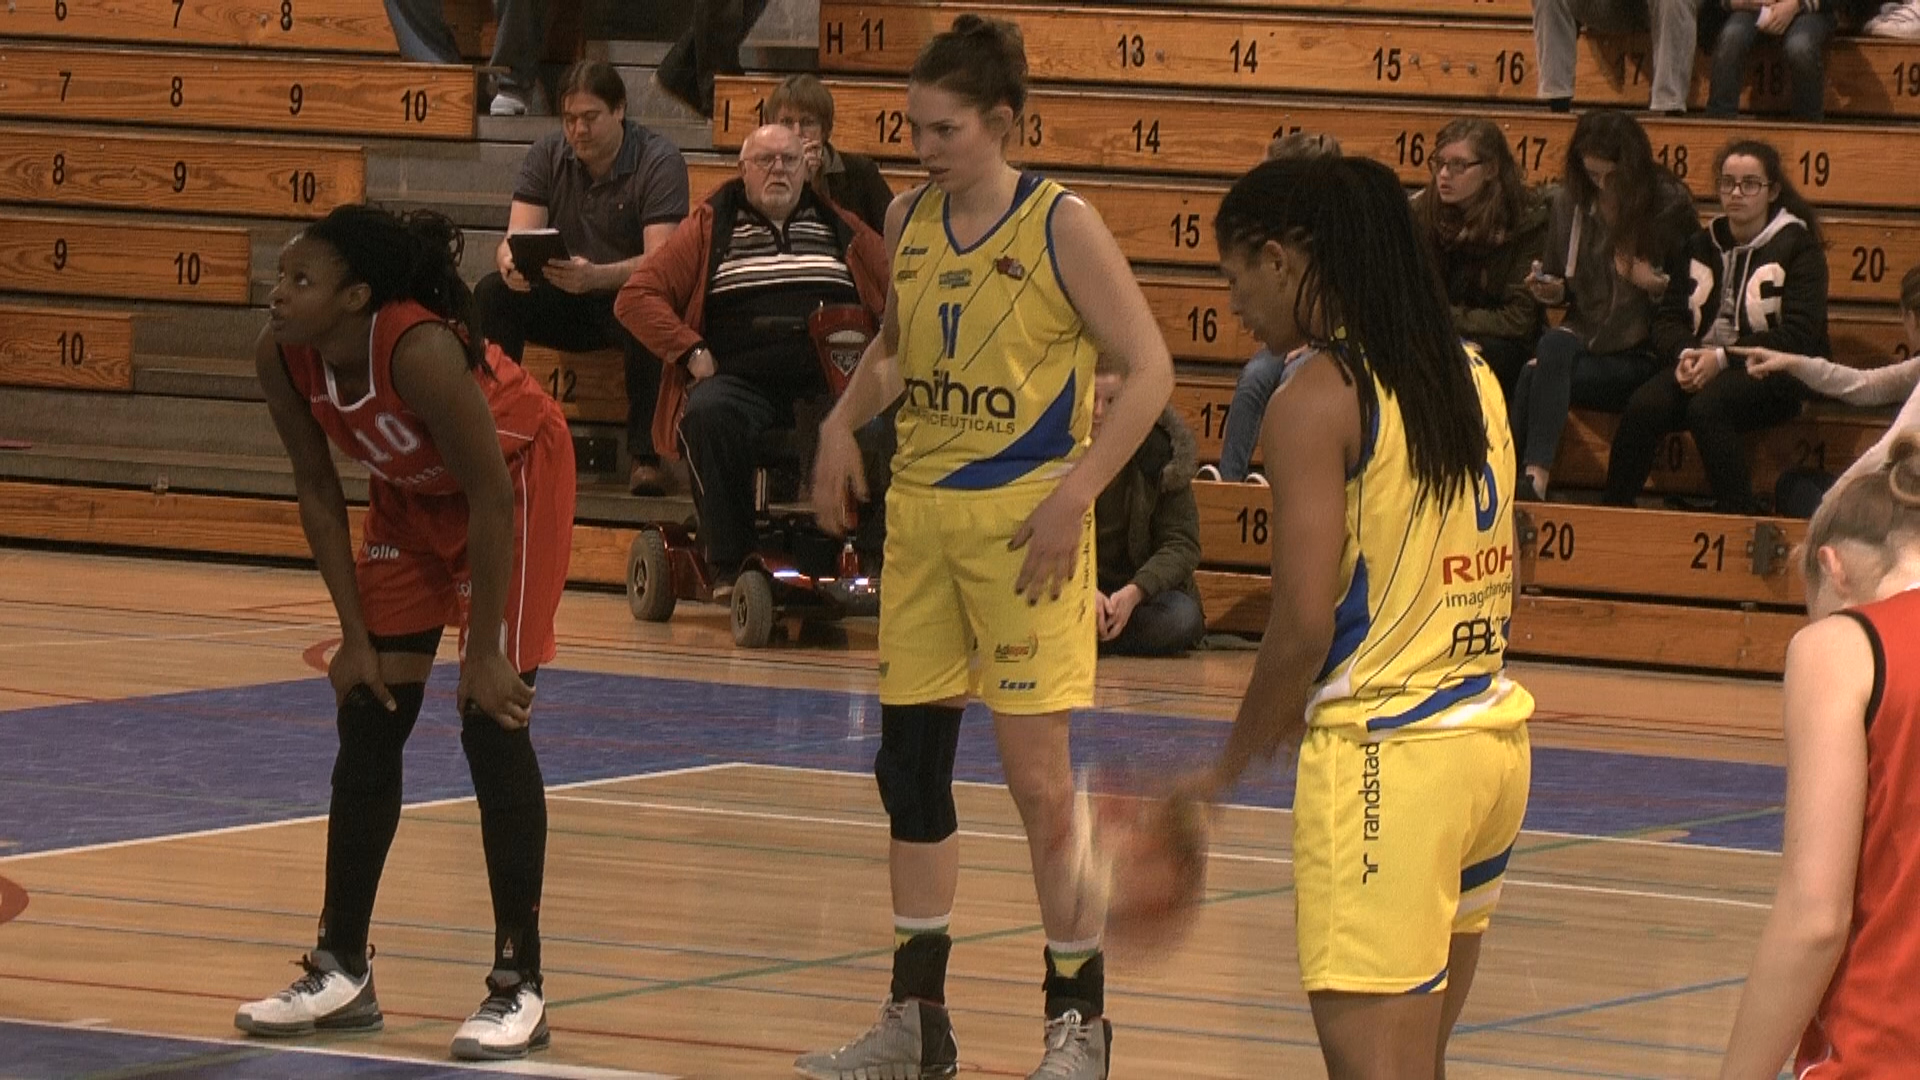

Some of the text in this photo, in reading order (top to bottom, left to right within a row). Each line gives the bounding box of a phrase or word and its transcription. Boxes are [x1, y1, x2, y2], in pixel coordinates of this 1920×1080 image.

[172, 0, 185, 28] 7
[280, 0, 293, 31] 8
[826, 18, 885, 54] H 11
[1117, 34, 1145, 68] 13
[1230, 39, 1259, 74] 14
[1373, 47, 1401, 82] 15
[1495, 50, 1525, 85] 16
[1615, 51, 1644, 86] 17
[58, 71, 72, 101] 7
[170, 76, 183, 107] 8
[1893, 61, 1920, 97] 19
[289, 84, 303, 115] 9
[401, 90, 427, 122] 10
[755, 98, 765, 127] 1
[875, 109, 903, 144] 12
[1016, 113, 1042, 147] 13
[1132, 119, 1160, 154] 14
[1395, 131, 1425, 167] 16
[1516, 136, 1547, 171] 17
[1658, 144, 1688, 179] 18
[52, 153, 65, 185] 8
[173, 161, 187, 193] 9
[1800, 151, 1830, 187] 19
[289, 170, 316, 204] 10
[1170, 213, 1200, 249] 15
[54, 238, 68, 271] 9
[174, 252, 200, 285] 10
[1851, 246, 1885, 283] 20
[938, 302, 961, 359] 11
[1187, 306, 1217, 343] 16
[57, 332, 84, 366] 10
[549, 367, 577, 396] 12
[354, 412, 421, 463] 10
[1201, 402, 1230, 439] 17
[1237, 506, 1268, 545] 18
[1539, 521, 1575, 561] 20
[1691, 532, 1725, 572] 21
[1358, 742, 1380, 841] randstad
